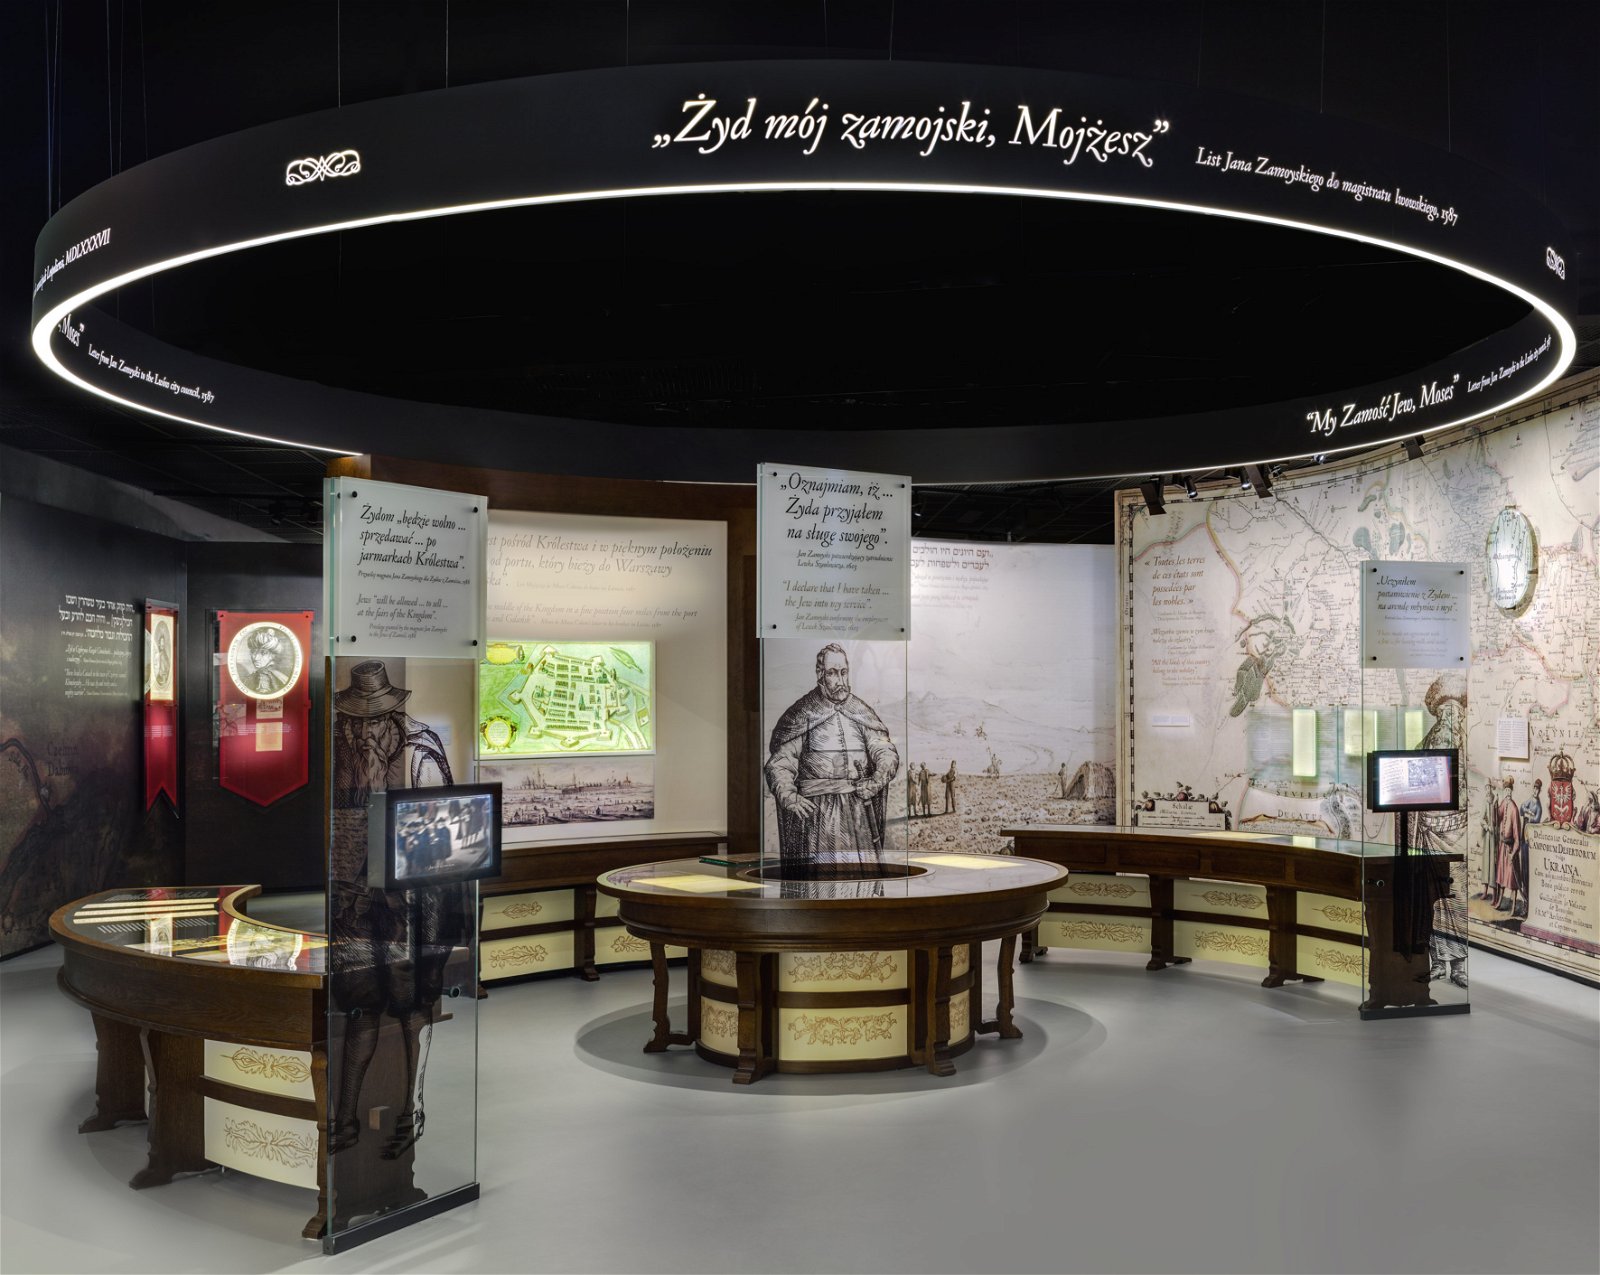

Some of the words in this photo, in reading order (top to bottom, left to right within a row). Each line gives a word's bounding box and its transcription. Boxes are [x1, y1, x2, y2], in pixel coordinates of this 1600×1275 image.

[651, 93, 758, 154] „Żyd
[765, 97, 829, 155] mój
[841, 101, 997, 157] zamojski,
[1008, 104, 1170, 167] Mojżesz”
[1195, 146, 1222, 167] List
[1221, 151, 1252, 172] Jana
[1255, 156, 1324, 192] Zamoyskiego
[1326, 171, 1340, 189] do
[1342, 179, 1392, 202] magistratu
[1395, 187, 1440, 221] lwowskiego,
[1441, 206, 1459, 227] 1587
[65, 227, 112, 266] MDLXXXVII
[98, 350, 110, 366] from
[107, 355, 118, 369] Jan
[146, 370, 154, 384] the
[170, 381, 181, 395] city
[201, 390, 215, 404] 1587
[1306, 407, 1337, 436] “My
[1340, 394, 1392, 428] Zamość
[1388, 392, 1417, 422] Jew,
[1419, 373, 1460, 409] Moses”
[780, 472, 864, 499] „Oznajmiam,
[360, 502, 395, 525] Żydom
[396, 509, 431, 530] „będzie
[432, 514, 456, 530] wolno
[785, 494, 820, 520] Żyda
[822, 502, 884, 524] przyjąłem
[359, 528, 416, 547] sprzedawać
[425, 536, 437, 552] po
[499, 534, 533, 555] pośród
[536, 535, 589, 552] Królestwa
[599, 543, 610, 552] w
[610, 540, 658, 559] pięknym
[659, 541, 713, 560] położeniu
[787, 527, 802, 539] na
[805, 523, 837, 547] sługę
[839, 527, 888, 551] swojego”.
[357, 548, 413, 566] jarmarkach
[415, 551, 466, 570] Królestwa”.
[490, 552, 503, 567] od
[503, 555, 535, 574] portu,
[538, 556, 565, 575] który
[567, 556, 596, 575] bieży
[598, 557, 611, 573] do
[615, 558, 673, 578] Warszawy
[1153, 556, 1175, 566] Toutes
[1176, 555, 1186, 565] les
[1187, 557, 1206, 565] terres
[1152, 570, 1161, 579] de
[1173, 569, 1189, 579] états
[1190, 570, 1204, 578] sont
[792, 580, 819, 593] declare
[819, 581, 835, 593] that
[843, 583, 860, 594] have
[861, 583, 881, 595] taken
[1183, 584, 1196, 595] par
[1427, 588, 1451, 601] Żydem
[356, 593, 372, 606] Jews
[389, 595, 396, 605] be
[396, 596, 419, 606] allowed
[432, 598, 443, 608] sell
[535, 604, 565, 616] Kingdom
[652, 606, 671, 619] from
[671, 607, 683, 617] the
[682, 610, 698, 621] port
[784, 595, 797, 607] the
[796, 596, 812, 609] Jew
[814, 599, 829, 608] into
[830, 601, 842, 611] my
[1152, 596, 1161, 606] les
[365, 607, 375, 617] the
[389, 608, 398, 621] of
[397, 608, 406, 618] the
